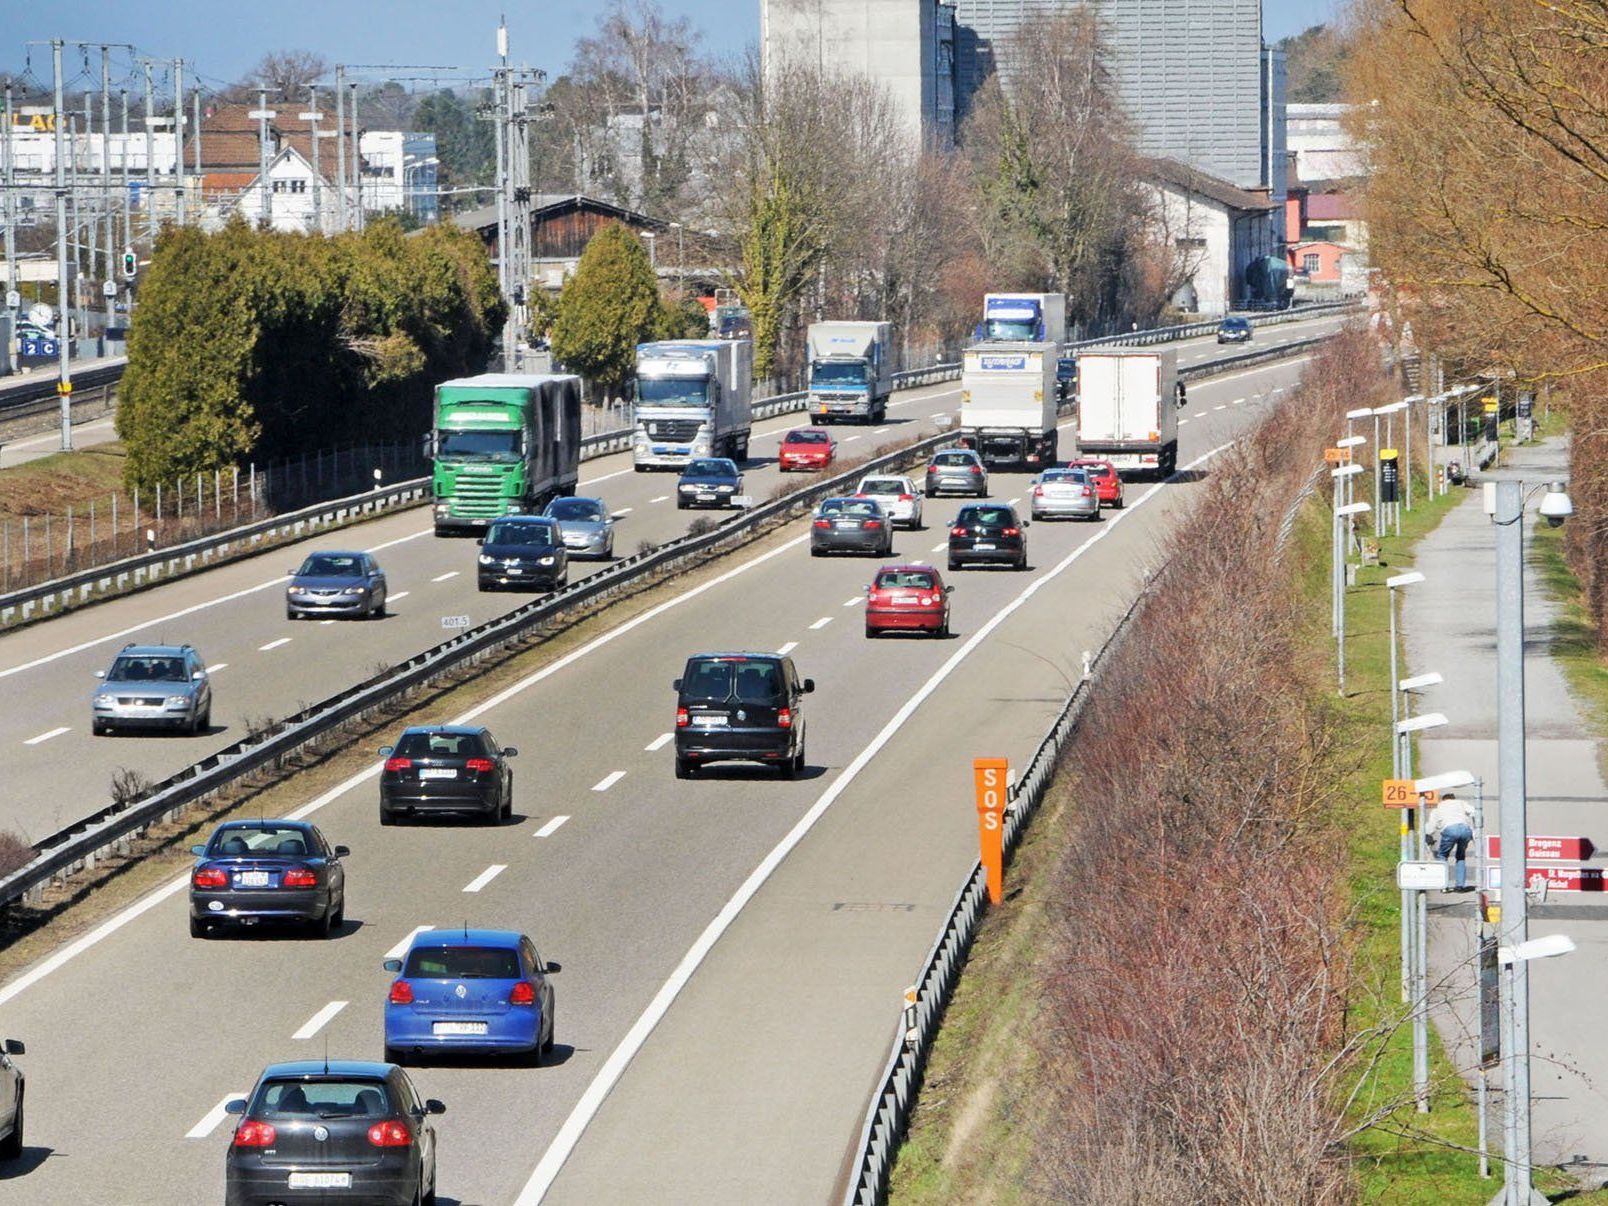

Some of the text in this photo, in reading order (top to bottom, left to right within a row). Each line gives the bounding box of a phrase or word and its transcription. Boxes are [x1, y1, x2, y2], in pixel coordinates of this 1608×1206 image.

[27, 343, 54, 355] 2 C
[983, 768, 998, 830] SOS
[1528, 838, 1562, 850] Bregenz
